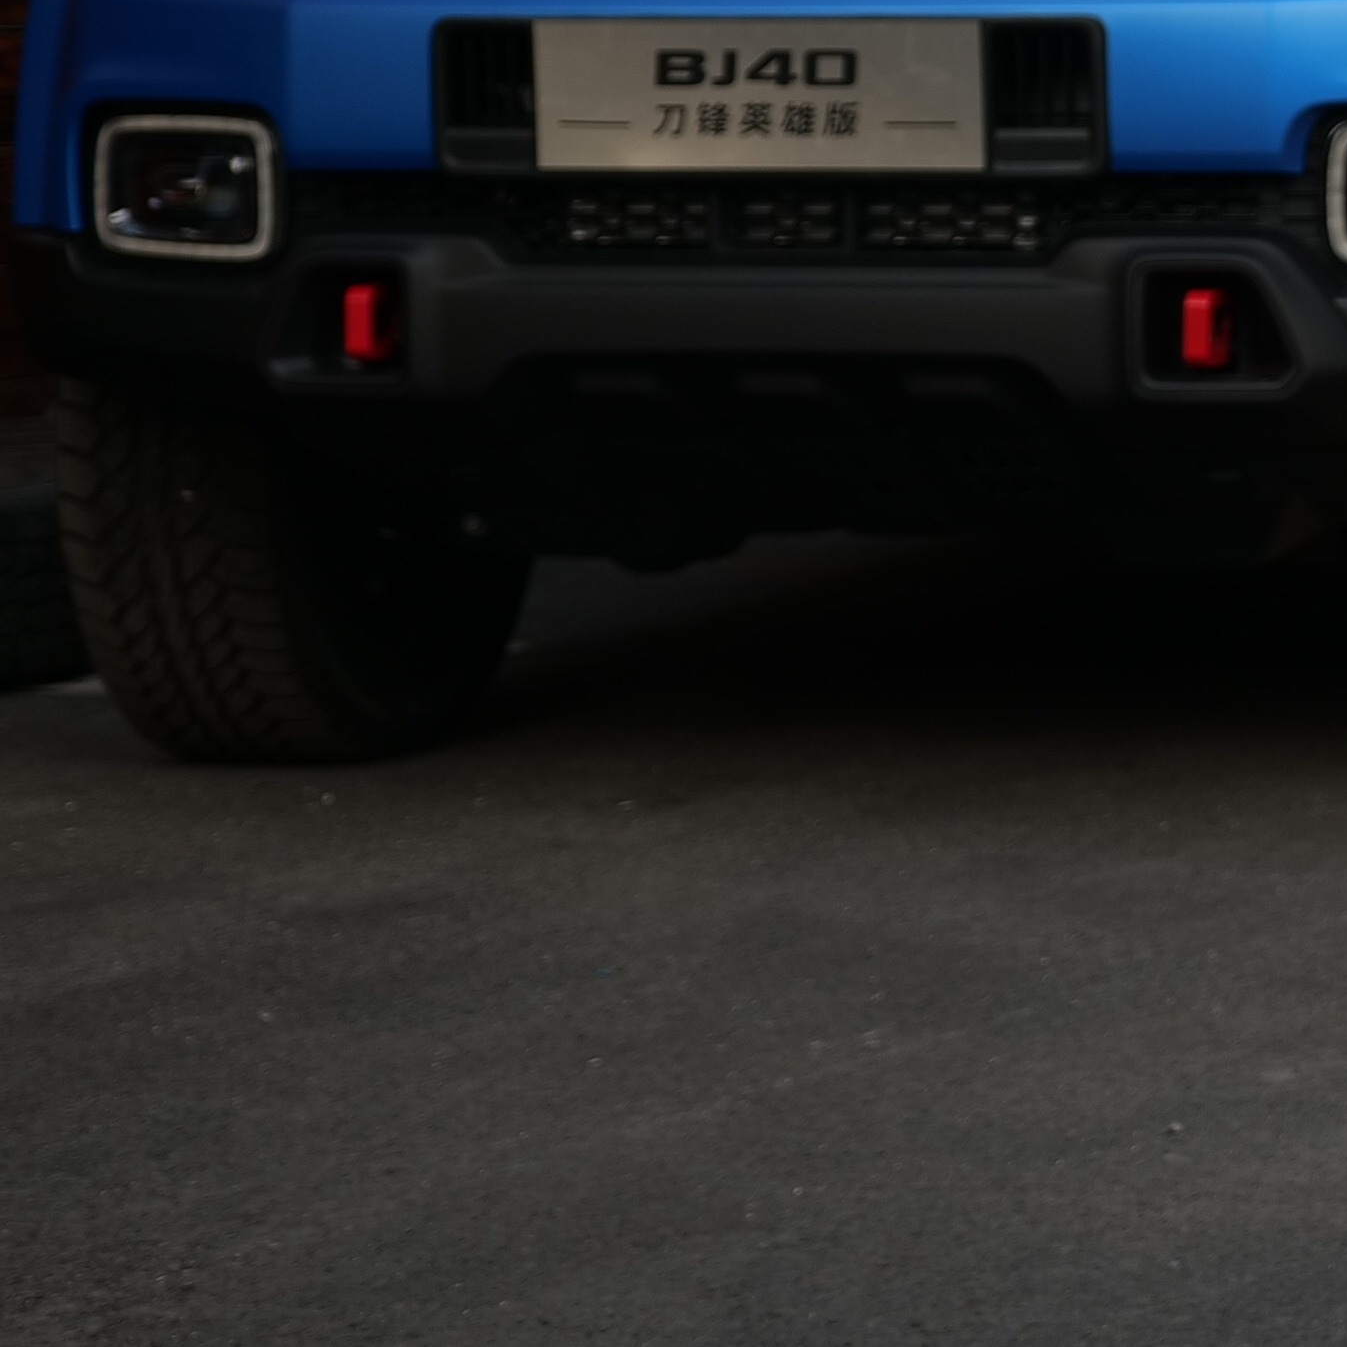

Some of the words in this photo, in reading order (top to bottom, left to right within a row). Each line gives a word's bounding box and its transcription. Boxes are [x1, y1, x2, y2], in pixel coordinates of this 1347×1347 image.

[655, 48, 858, 87] BJ40
[653, 101, 860, 137] 刀锋英雄版
